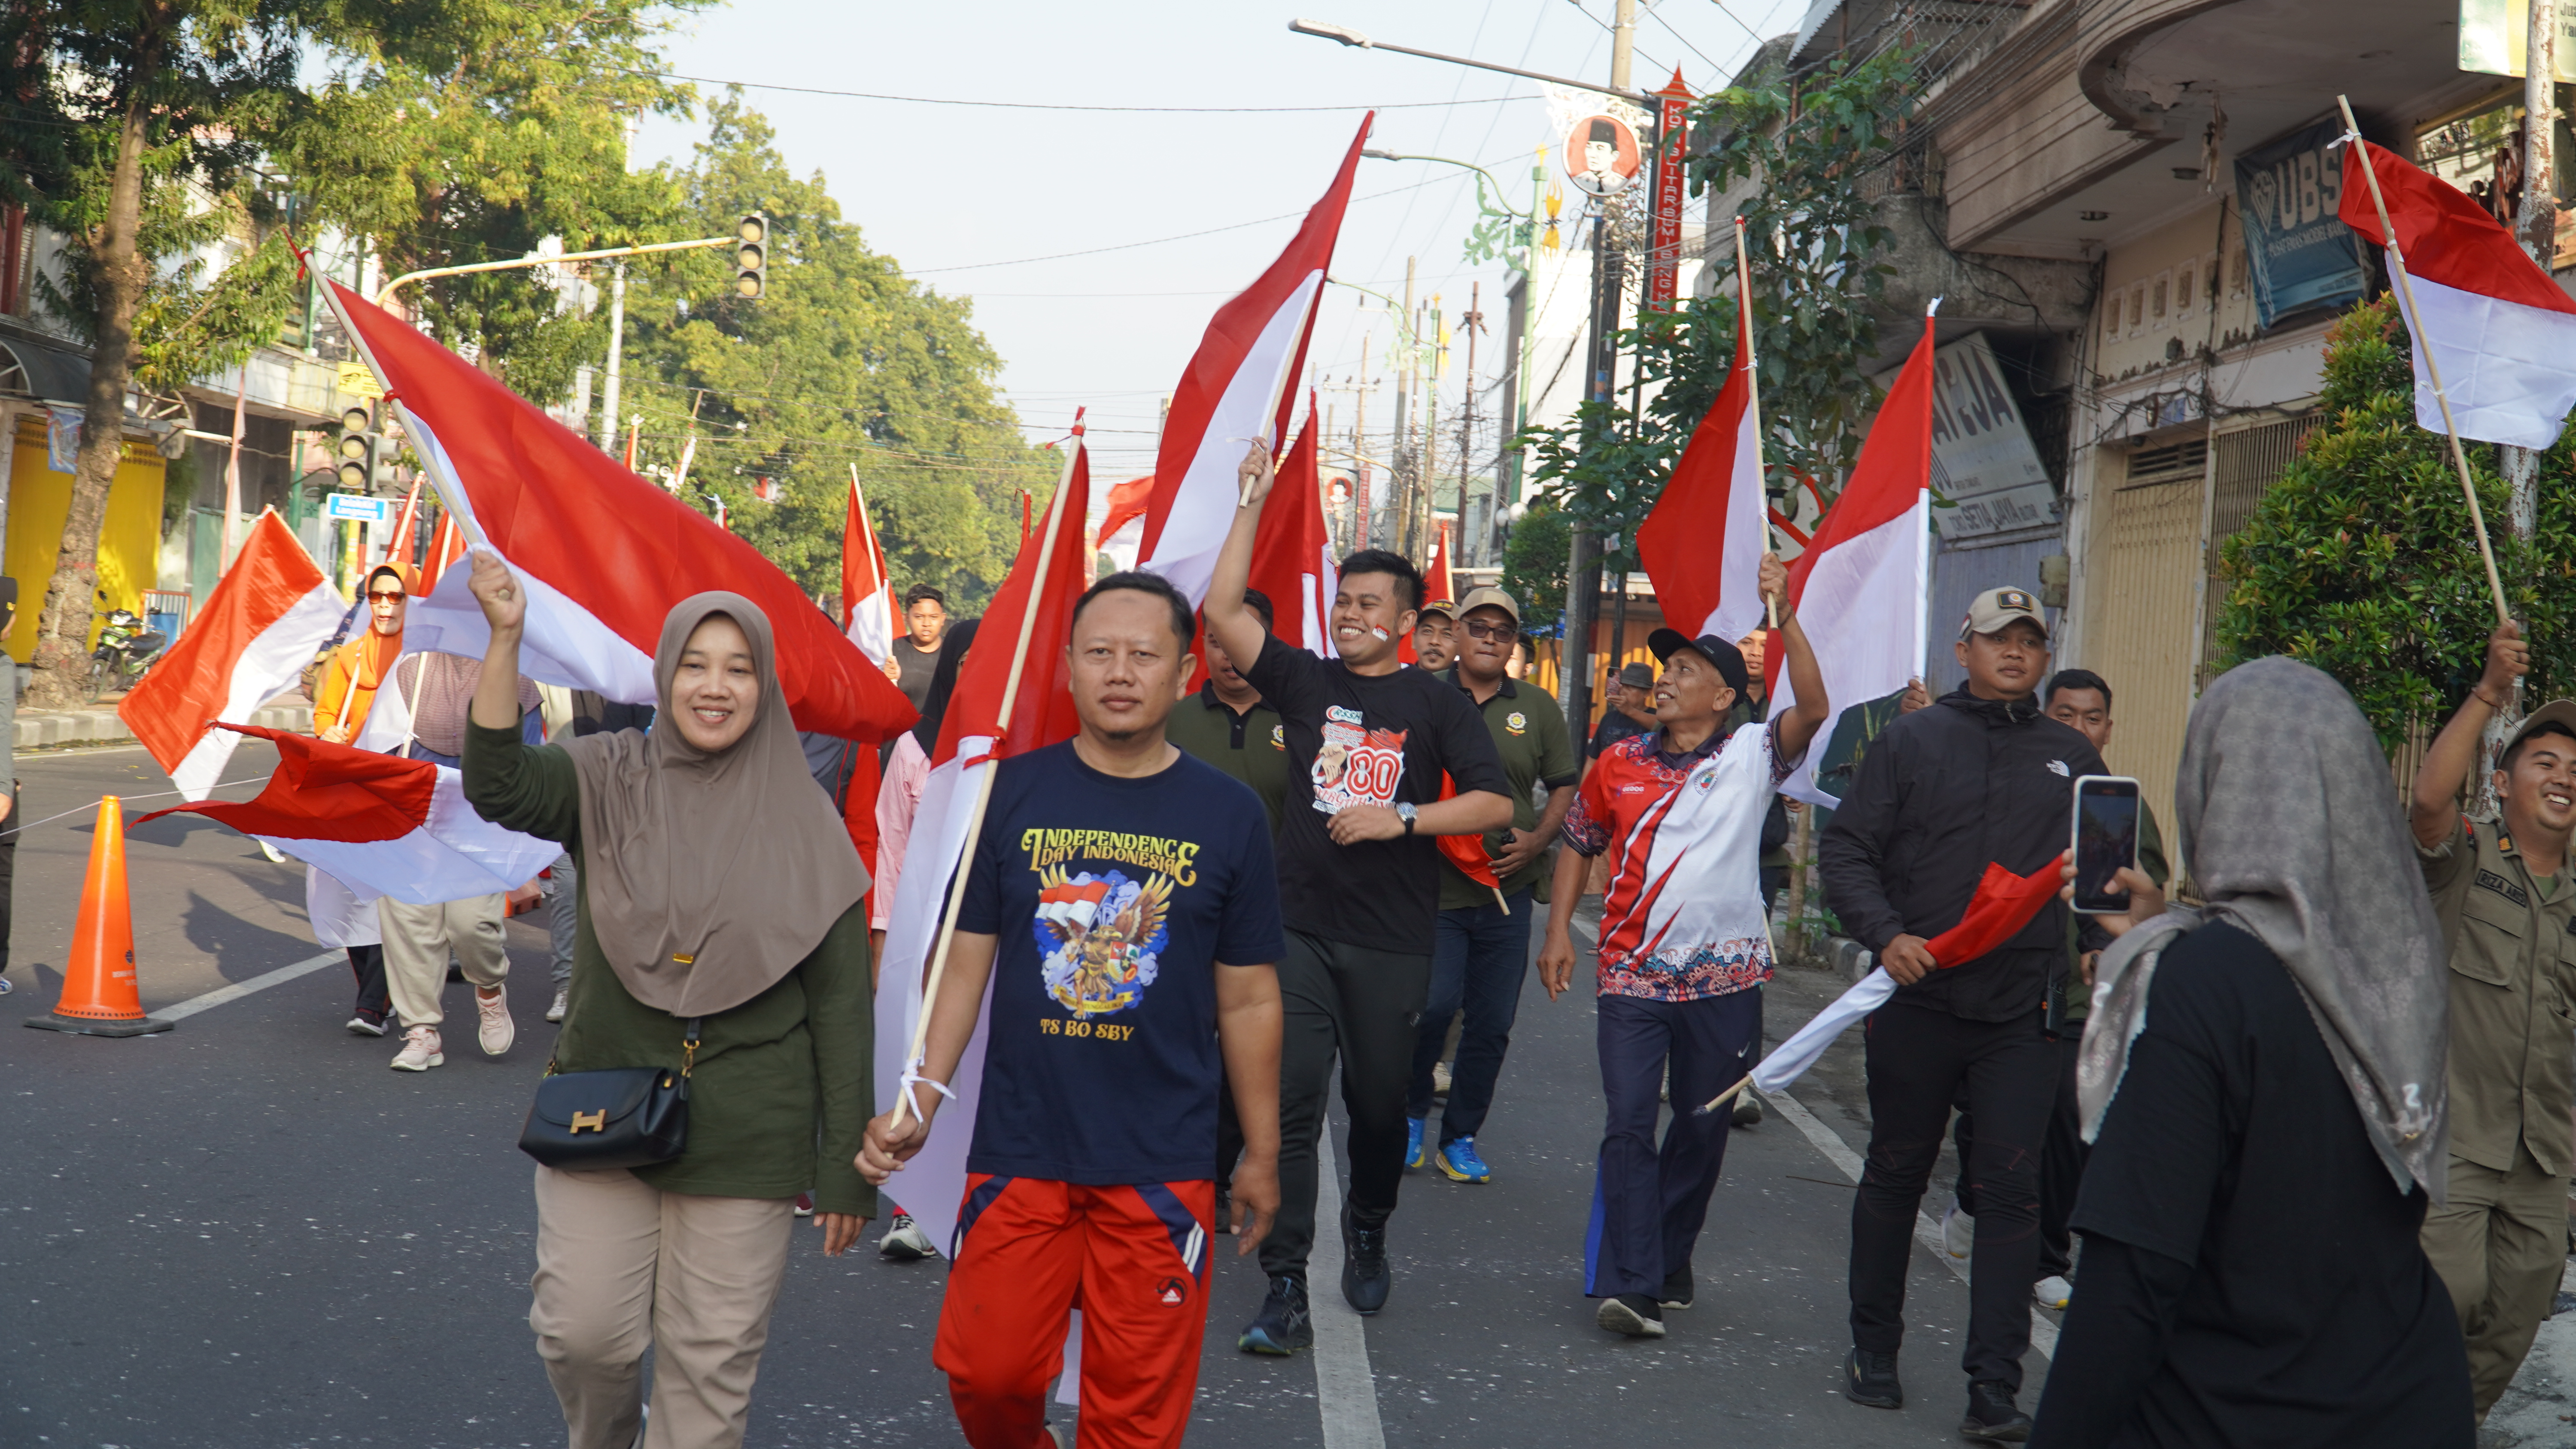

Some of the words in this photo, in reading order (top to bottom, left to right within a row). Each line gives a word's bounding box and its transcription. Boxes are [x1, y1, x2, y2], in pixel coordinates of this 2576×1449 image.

[2561, 22, 2576, 37] Ya
[2276, 142, 2342, 230] UBS
[1661, 207, 1676, 246] BUMI
[1961, 502, 1998, 530] SETIA
[1991, 497, 2023, 526] JAYA
[1346, 749, 1400, 800] 80
[1021, 828, 1200, 887] INDEPENDENCE
[1041, 845, 1077, 866] DAY
[1082, 845, 1175, 876] INDONESIA
[2481, 873, 2503, 891] RIZA
[1040, 1019, 1060, 1034] TS
[1064, 1020, 1091, 1037] BO
[1095, 1024, 1134, 1041] SBY
